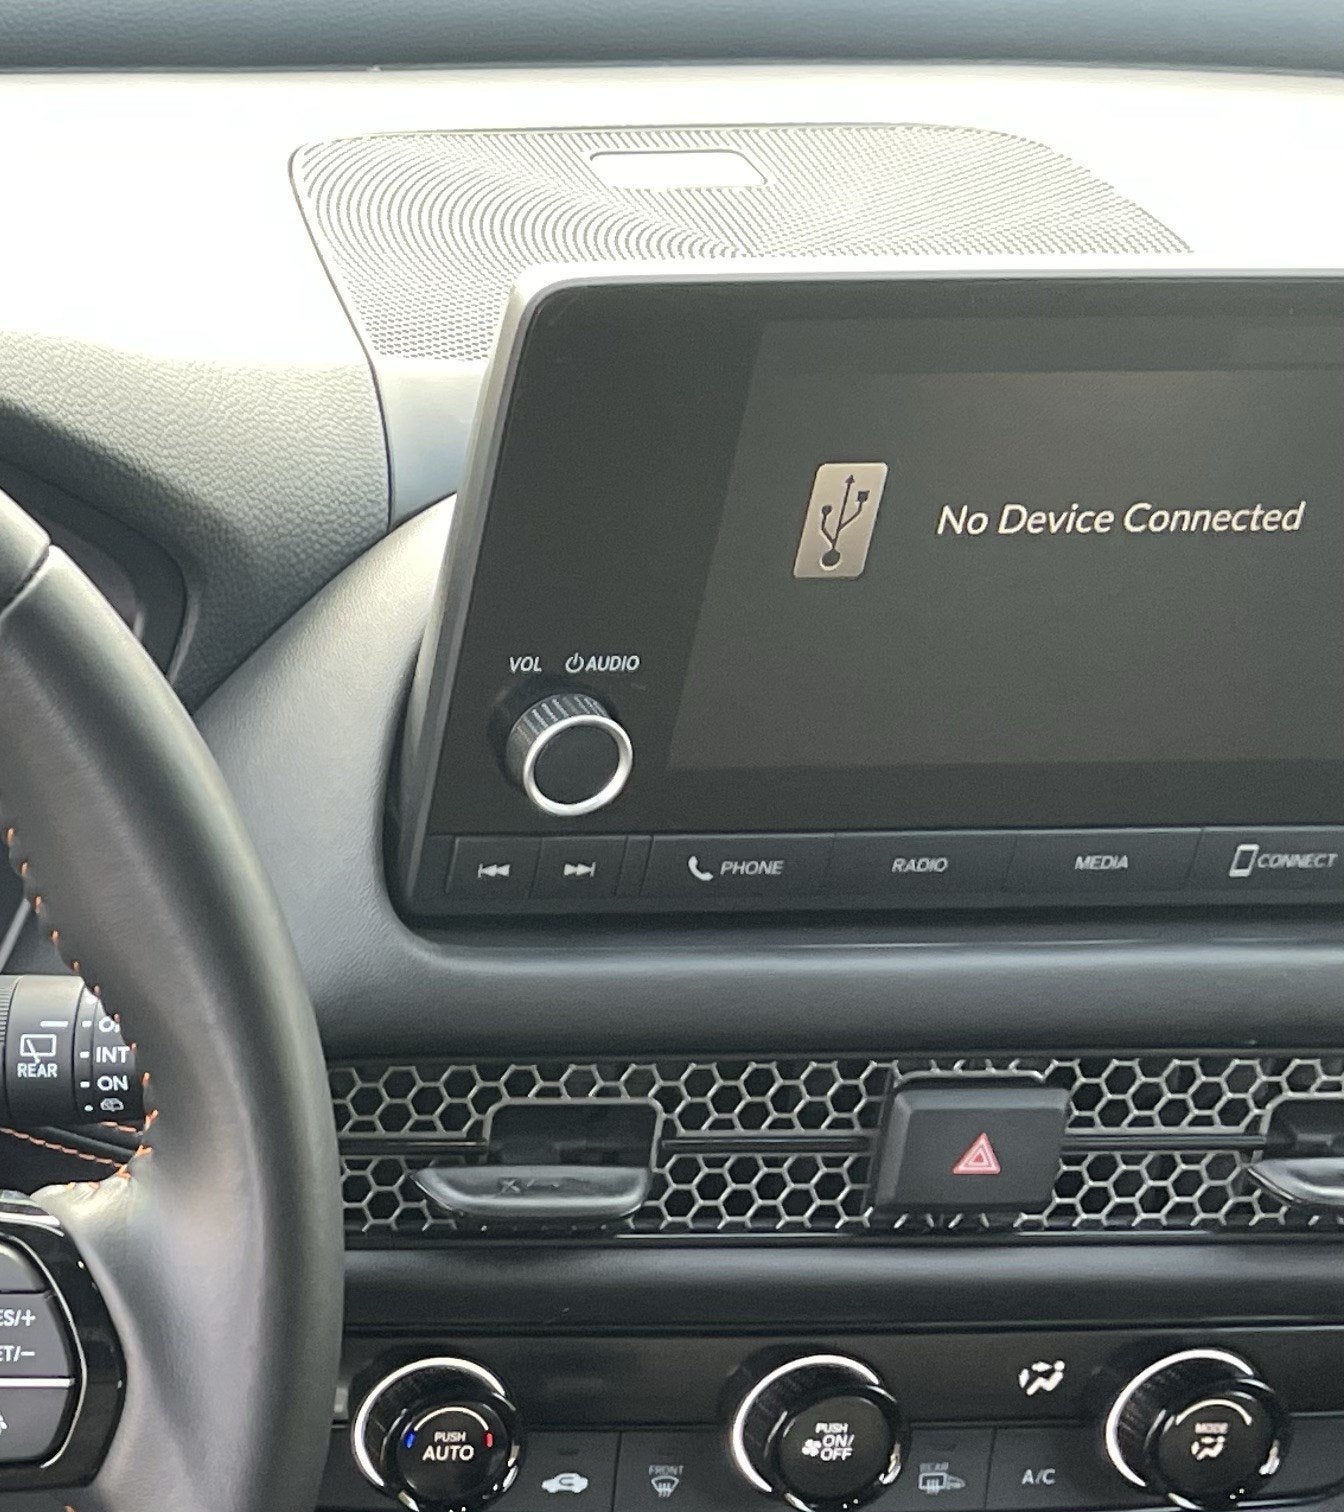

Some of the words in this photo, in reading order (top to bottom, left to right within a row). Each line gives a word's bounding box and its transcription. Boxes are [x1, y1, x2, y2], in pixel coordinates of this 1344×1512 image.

[937, 505, 988, 535] No
[998, 503, 1114, 533] Device
[1124, 501, 1306, 532] Connected
[509, 656, 542, 673] VOL
[585, 655, 640, 672] AUDIO
[720, 860, 784, 876] PHONE
[892, 857, 948, 873] RADIO
[1075, 855, 1129, 871] MEDIA
[1257, 853, 1337, 869] CONNECT
[96, 1046, 130, 1064] INT
[18, 1064, 57, 1079] REAR
[97, 1075, 128, 1091] ON
[815, 1422, 848, 1434] PUSH
[1195, 1422, 1228, 1434] MODE
[434, 1431, 466, 1443] PUSH
[823, 1434, 854, 1447] ON/
[423, 1445, 474, 1462] AUTO
[820, 1447, 852, 1461] OFF
[649, 1465, 683, 1476] FRONT
[1022, 1468, 1055, 1484] A/C
